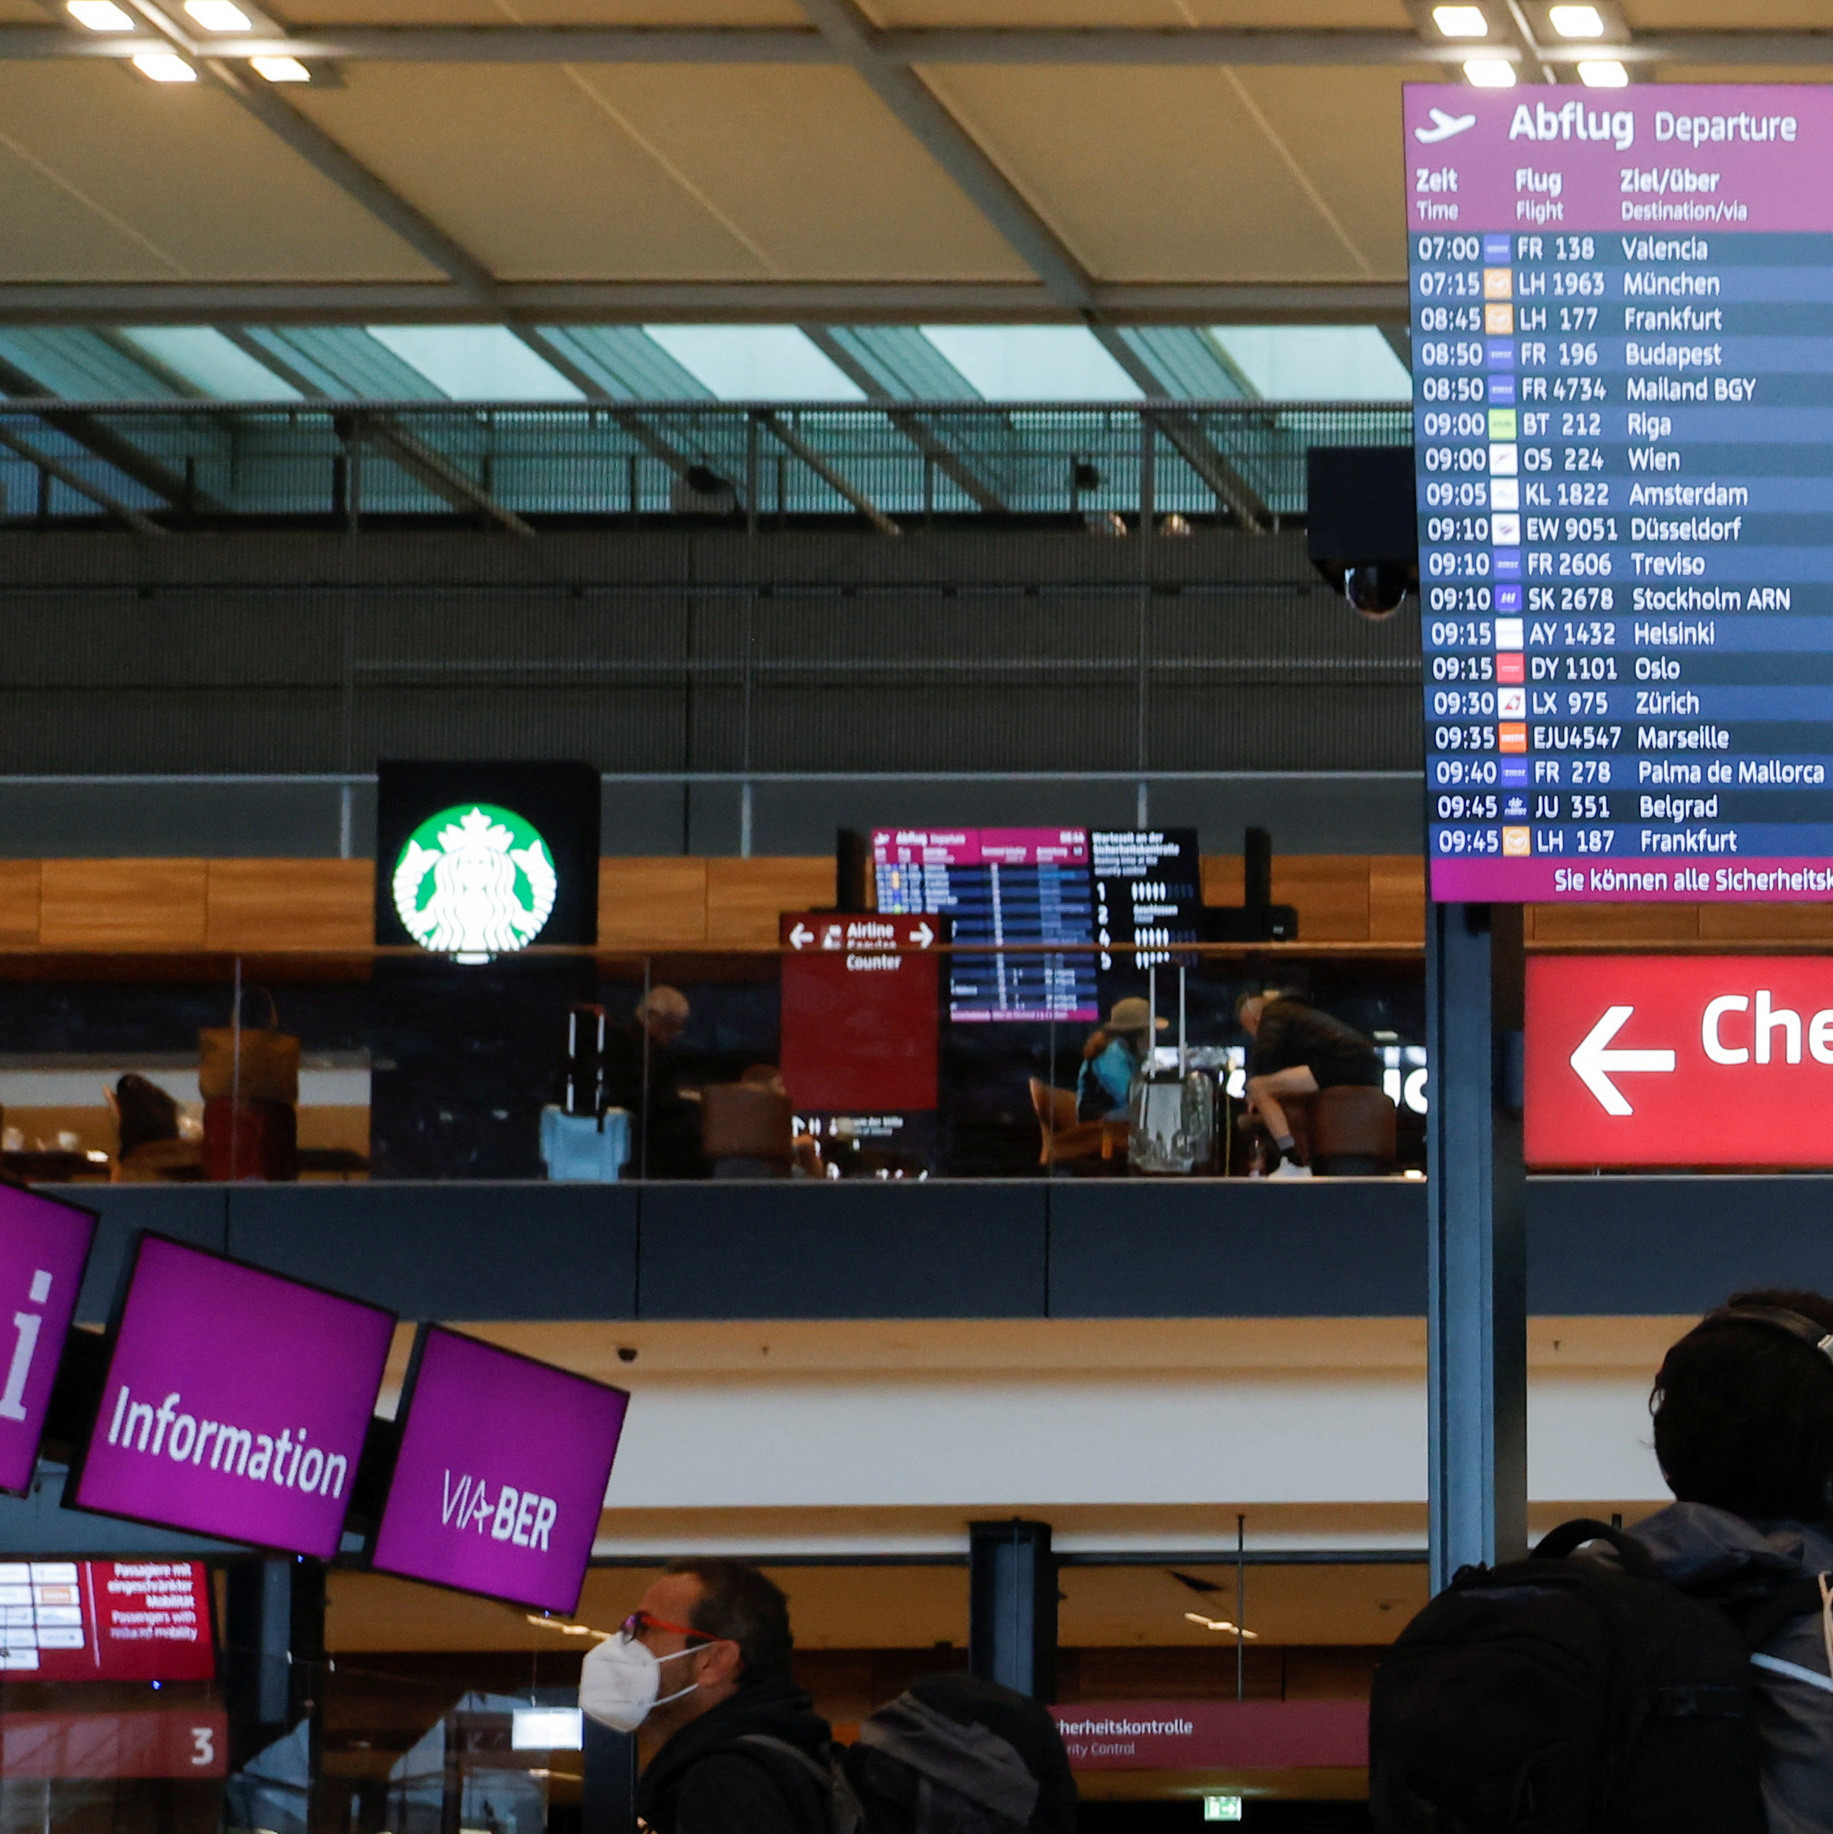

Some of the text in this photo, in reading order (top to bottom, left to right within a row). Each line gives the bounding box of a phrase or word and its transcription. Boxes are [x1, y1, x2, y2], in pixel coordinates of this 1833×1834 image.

[1509, 102, 1796, 150] Abflug Departure
[1417, 168, 1457, 192] Zeit
[1516, 168, 1561, 197] Flug
[1621, 167, 1720, 196] Ziel/über
[1417, 201, 1458, 221] Time
[1516, 200, 1563, 225] Flight
[1621, 200, 1747, 222] Destination/via
[1418, 237, 1480, 260] 07:00
[1518, 237, 1542, 259] FR
[1556, 237, 1595, 260] 138
[1621, 236, 1708, 260] Valencia
[1436, 726, 1496, 749] 09:35
[1535, 726, 1622, 750] EJU4547
[1637, 726, 1730, 750] Marseille
[1555, 868, 1584, 892] Sie
[1590, 867, 1668, 892] können
[1674, 868, 1710, 892] alle
[108, 1385, 347, 1499] Information
[191, 1727, 215, 1767] 3
[1091, 1742, 1136, 1756] Control
